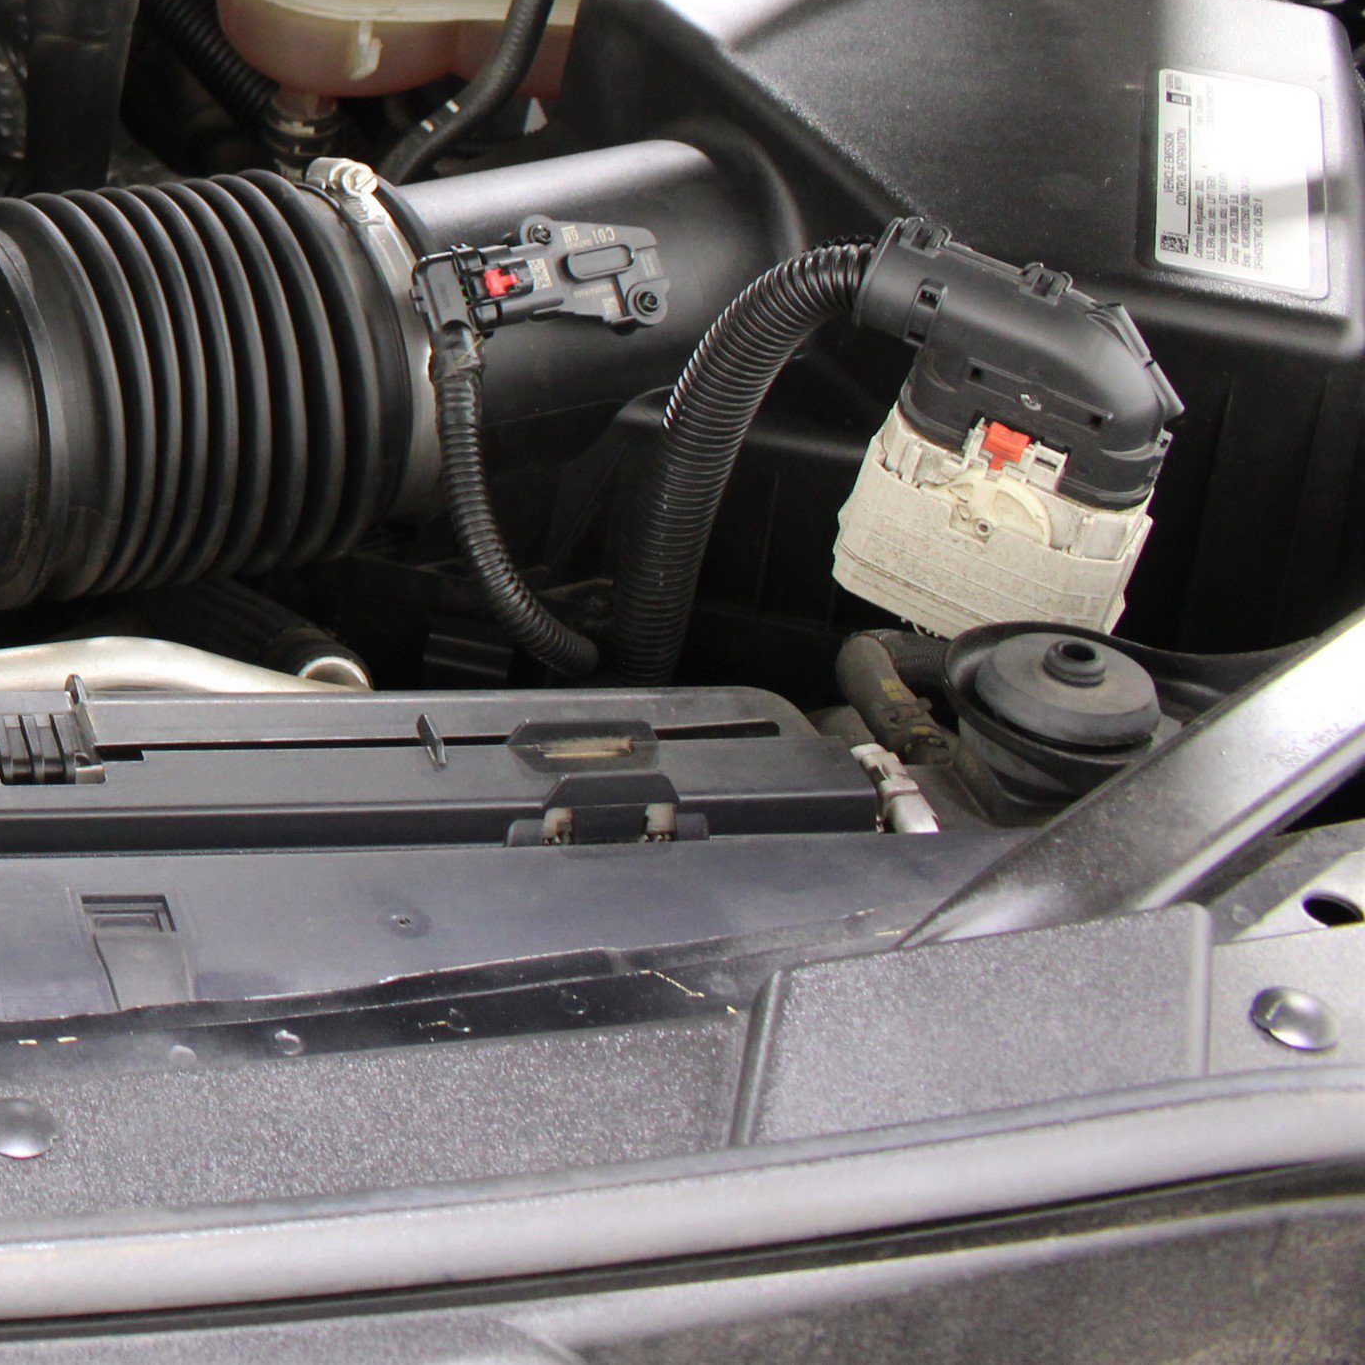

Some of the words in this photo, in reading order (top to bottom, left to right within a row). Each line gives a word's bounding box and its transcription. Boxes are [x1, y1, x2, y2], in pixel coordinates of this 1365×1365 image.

[1163, 132, 1174, 163] EMISSION
[1176, 128, 1187, 171] INFORMATION
[1163, 163, 1174, 193] VEHICLE
[1176, 173, 1187, 206] CONTROL
